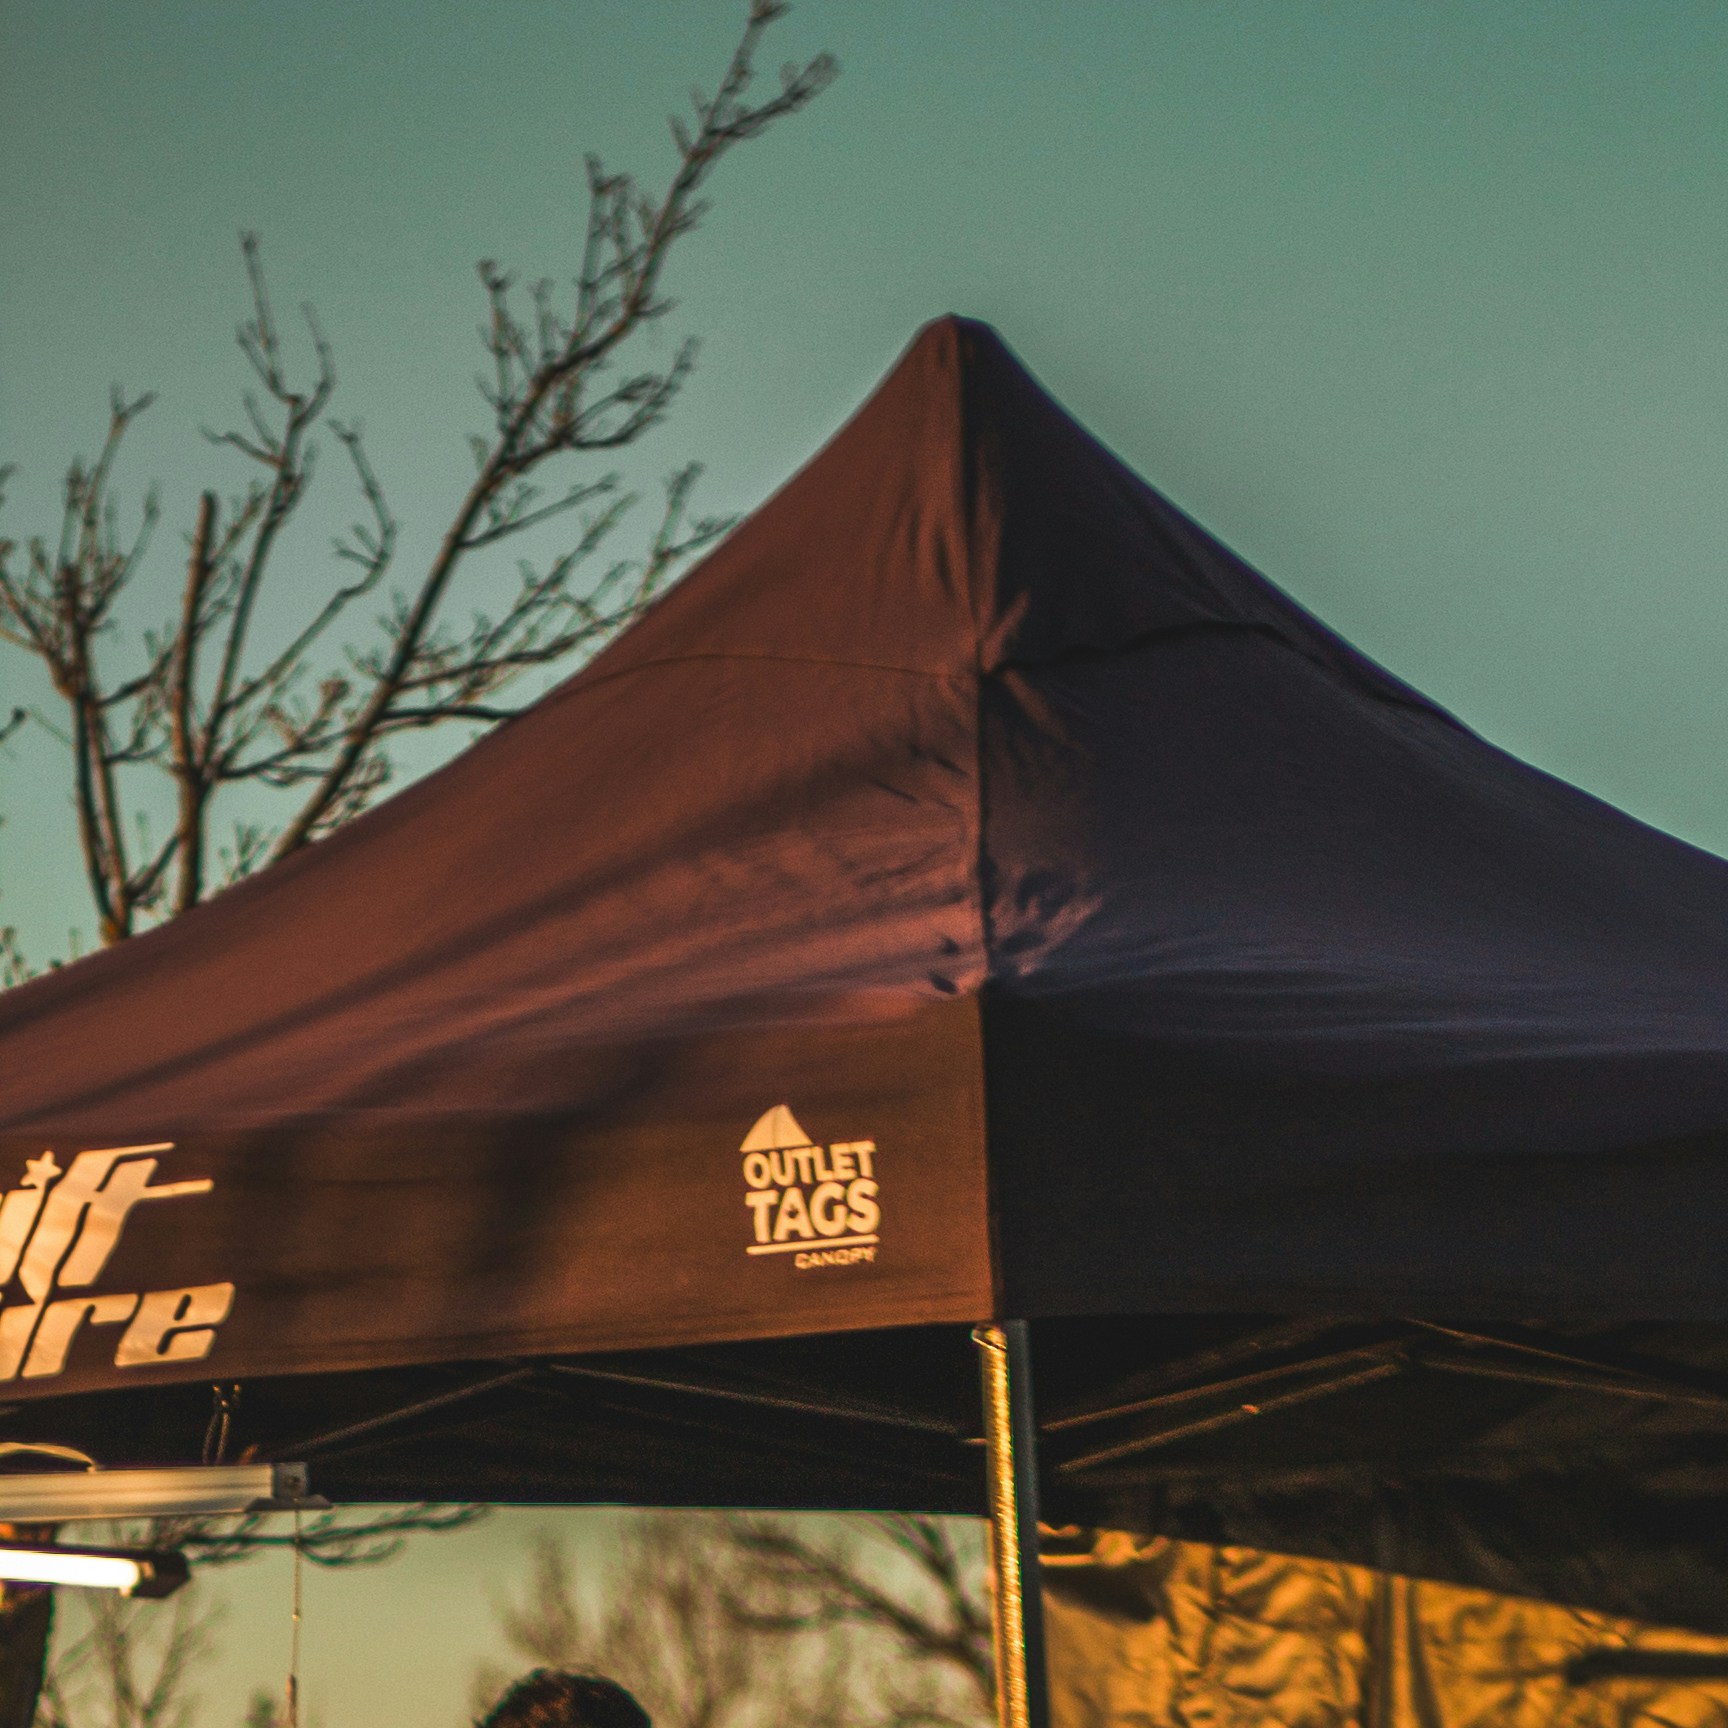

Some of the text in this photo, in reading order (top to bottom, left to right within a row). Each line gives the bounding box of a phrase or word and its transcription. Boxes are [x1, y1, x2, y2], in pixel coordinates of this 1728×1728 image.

[742, 1140, 877, 1190] OUTLET
[744, 1177, 882, 1244] TAGS
[794, 1247, 878, 1270] CANOPY
